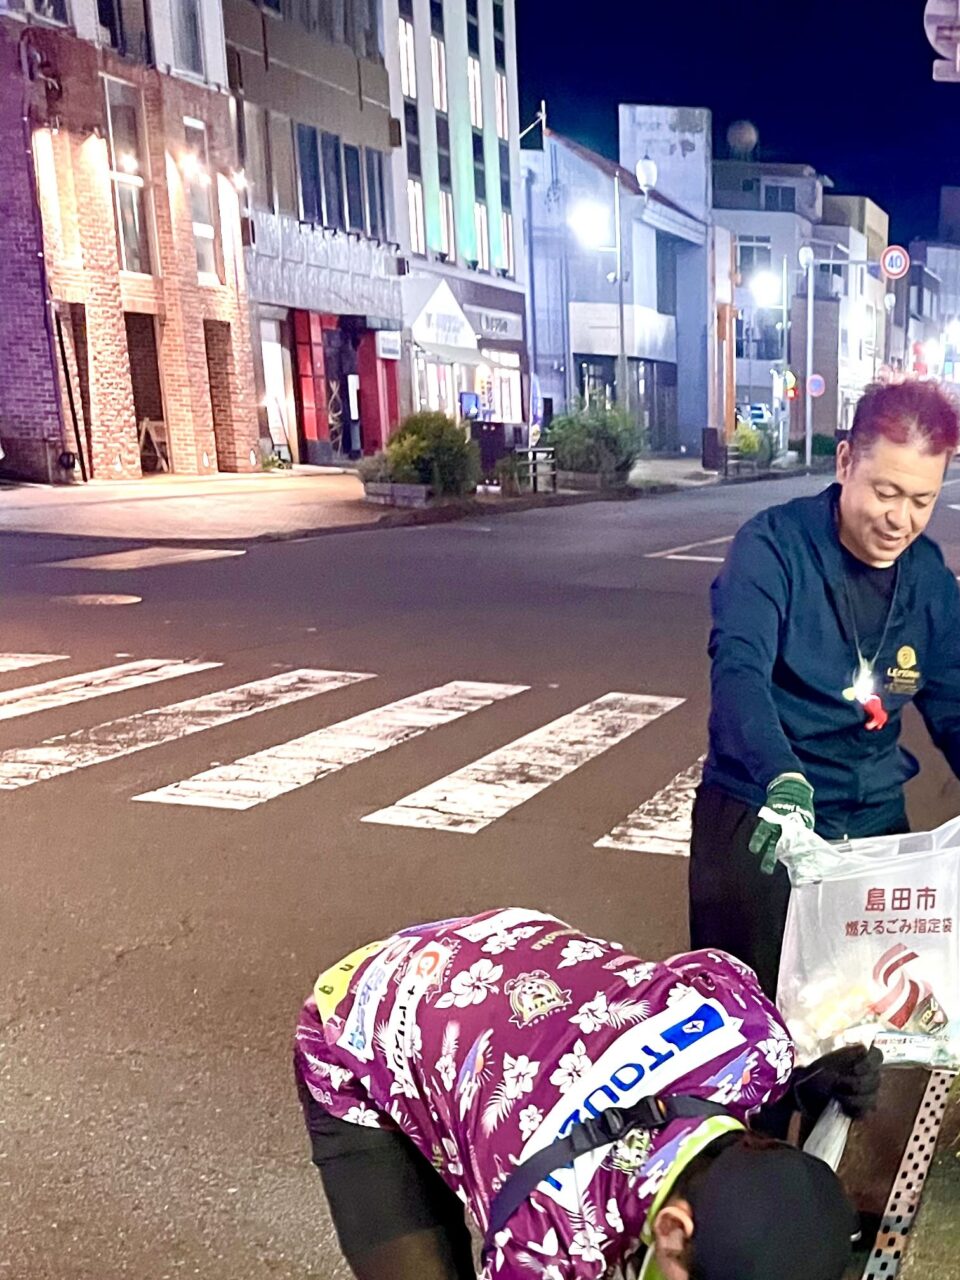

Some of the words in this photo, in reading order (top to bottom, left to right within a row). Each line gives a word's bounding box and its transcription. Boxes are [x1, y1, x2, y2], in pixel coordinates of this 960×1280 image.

[886, 255, 903, 270] 40
[865, 886, 937, 912] 島田市
[845, 918, 953, 937] 燃えるごみ指定袋
